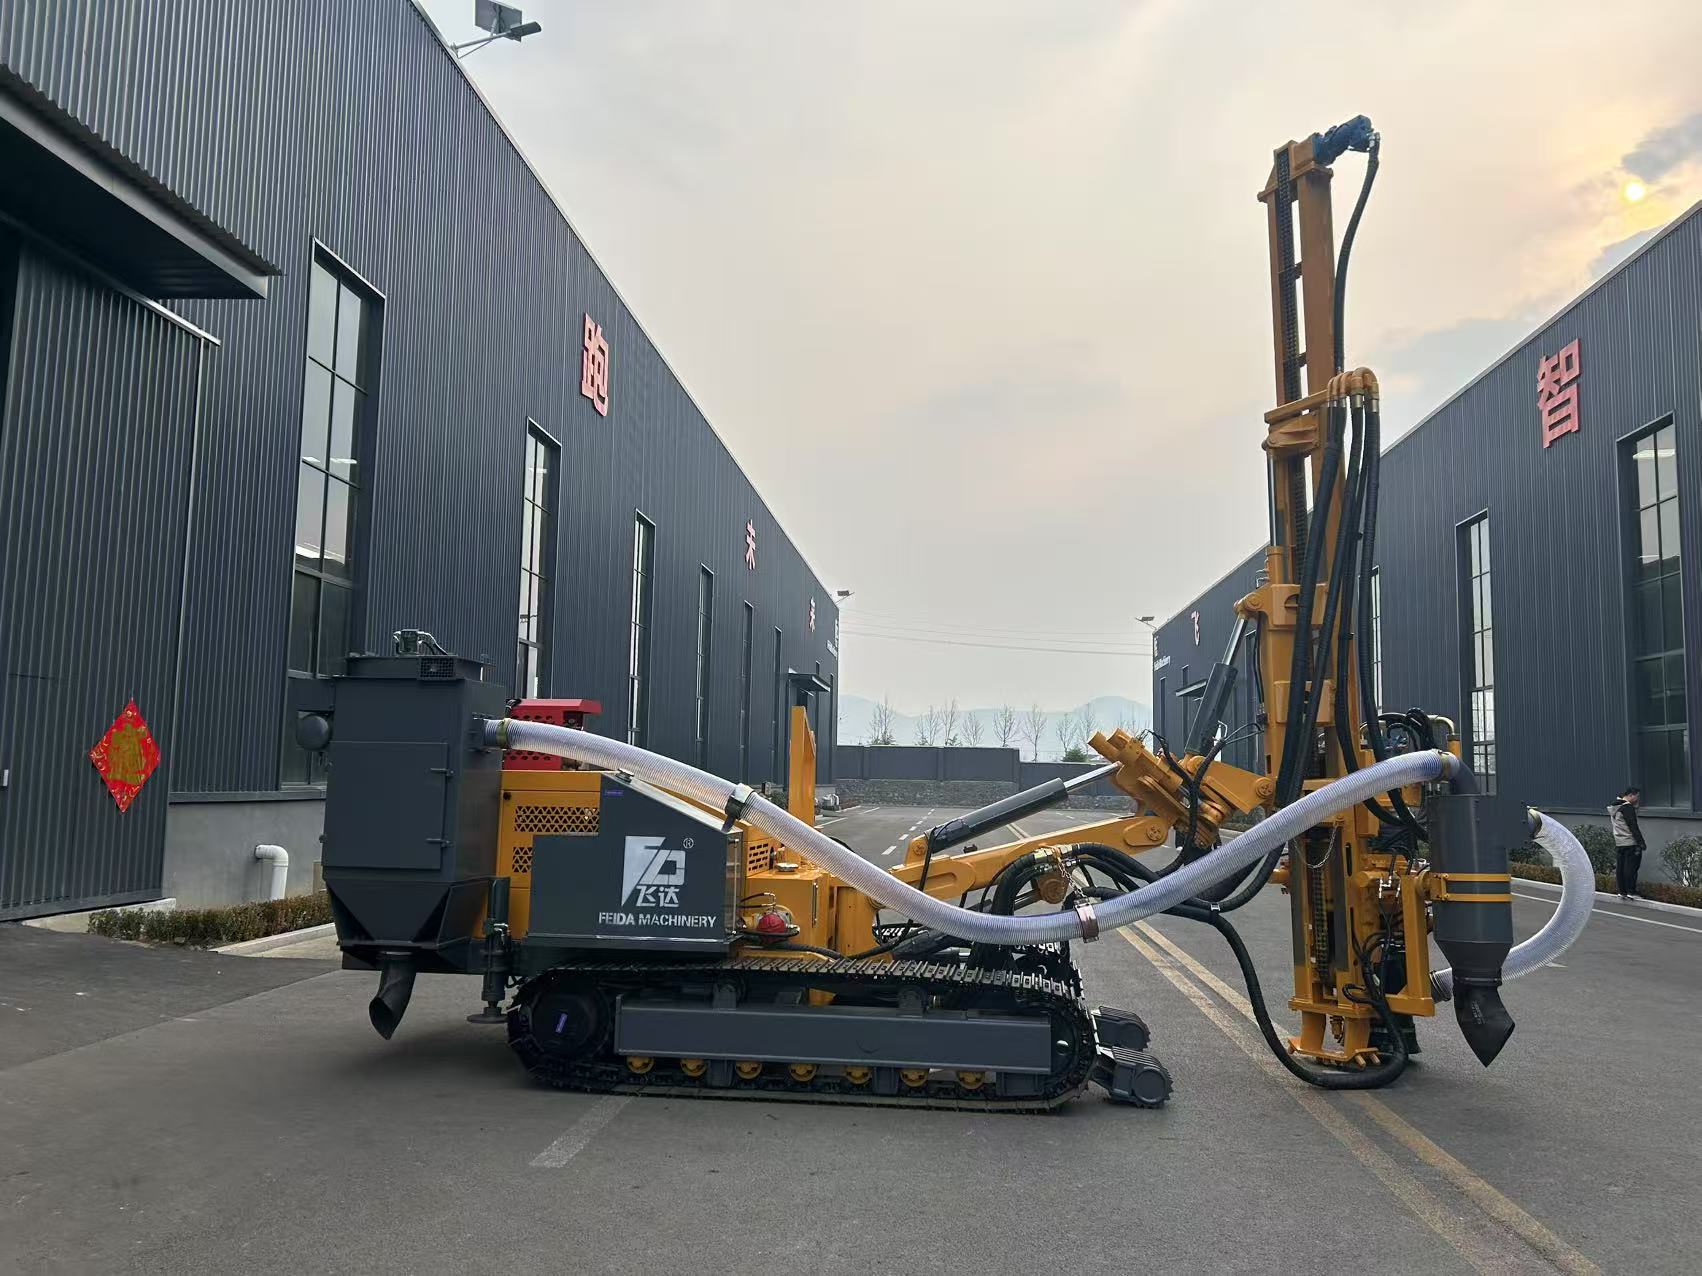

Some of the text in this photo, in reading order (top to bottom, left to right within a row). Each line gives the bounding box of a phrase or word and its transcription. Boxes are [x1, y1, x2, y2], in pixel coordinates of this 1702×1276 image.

[582, 312, 609, 417] 跑
[1537, 338, 1581, 449] 智
[598, 912, 717, 928] FEIDA MACHINERY
[635, 885, 680, 908] 飞达
